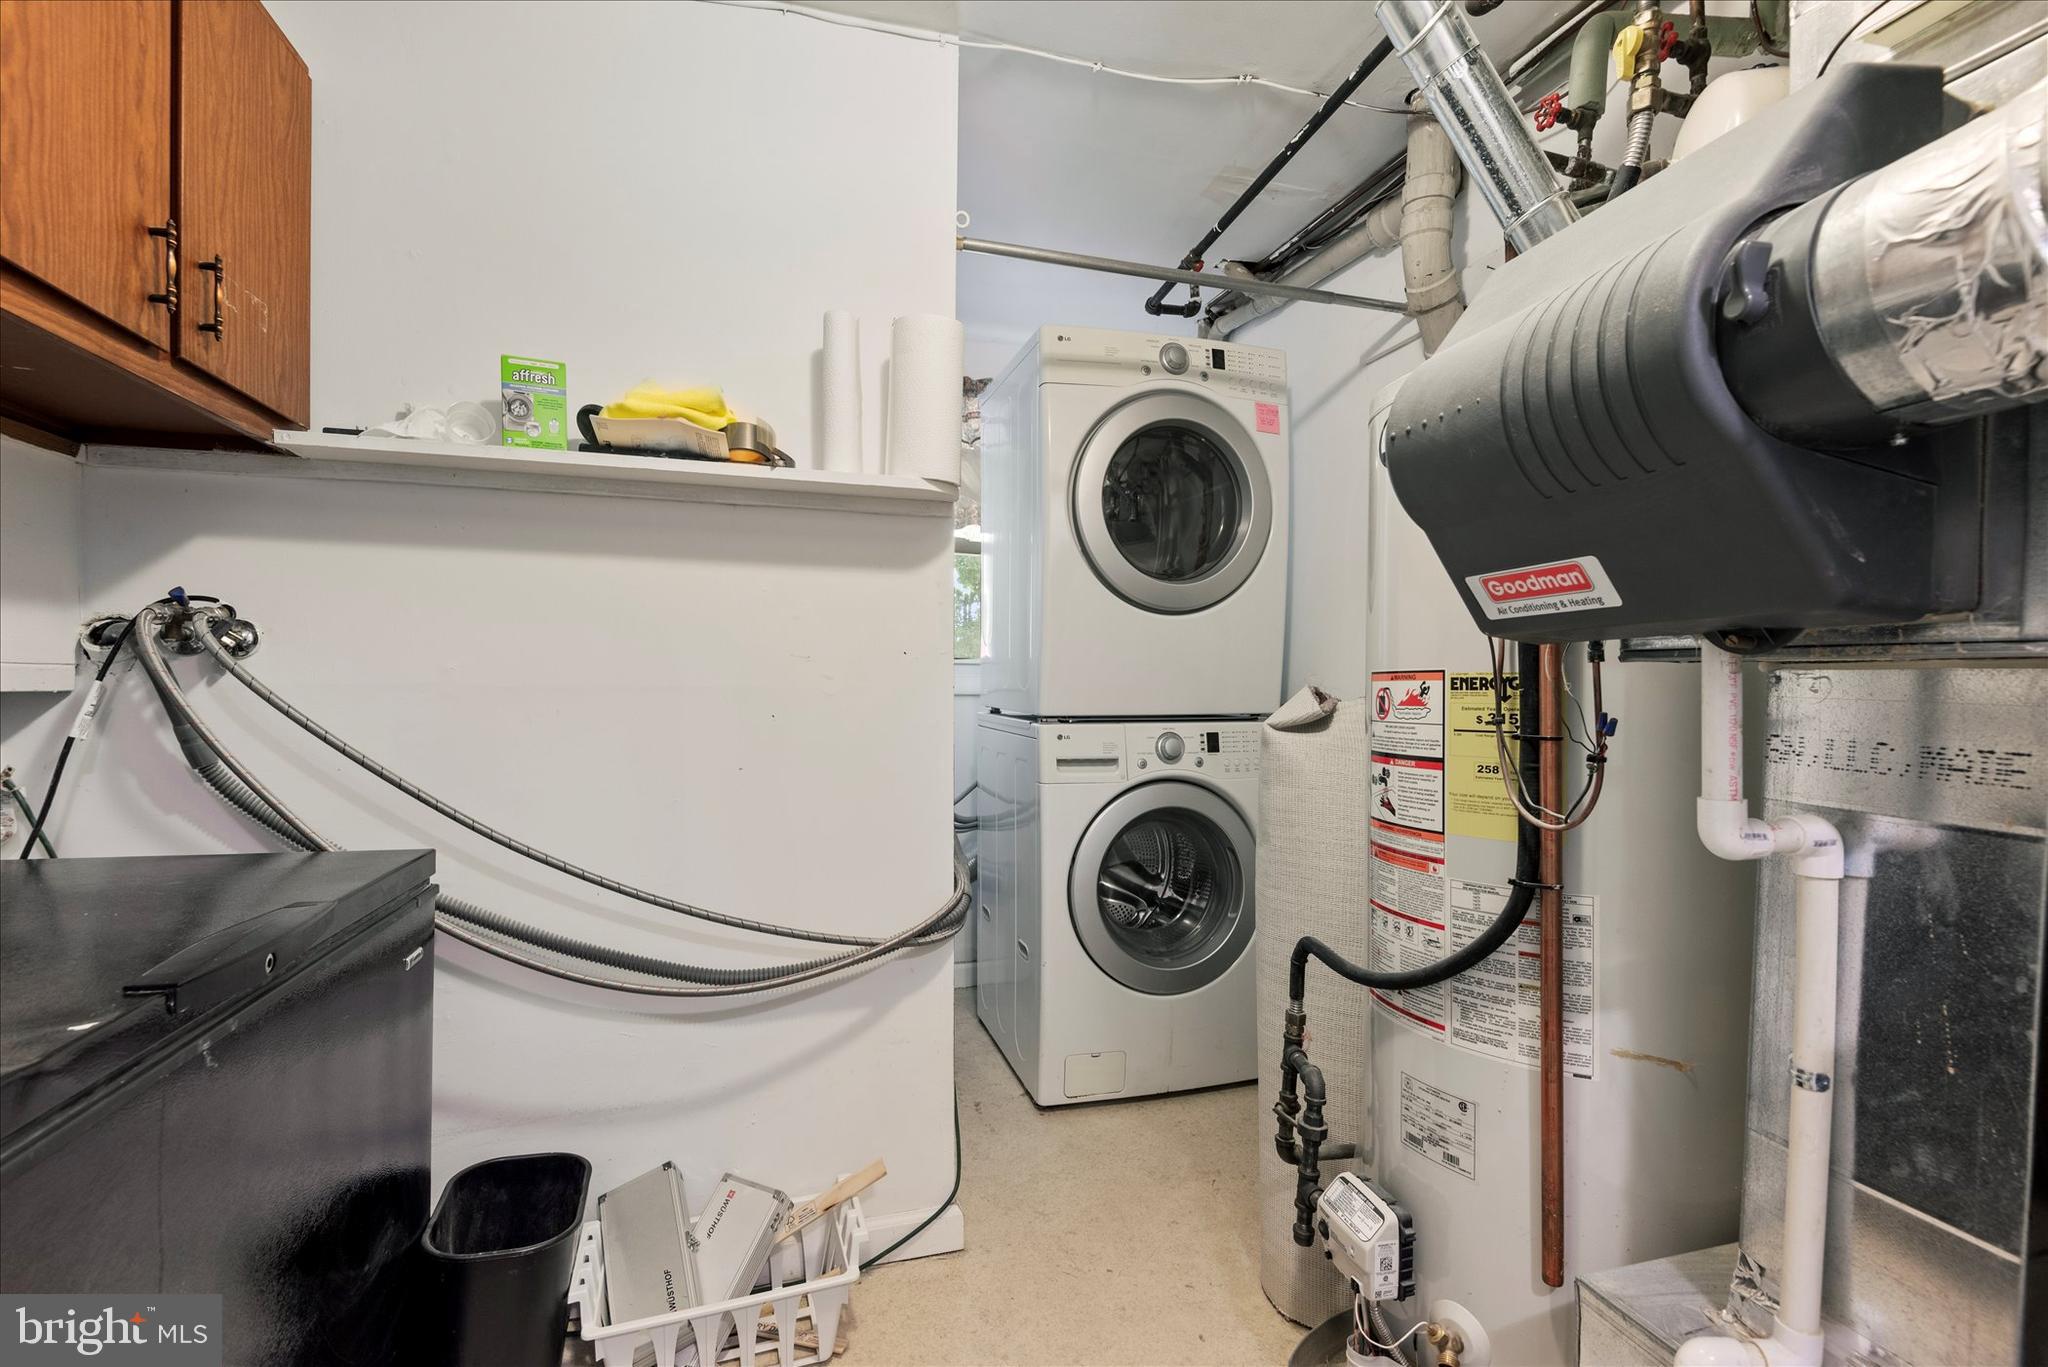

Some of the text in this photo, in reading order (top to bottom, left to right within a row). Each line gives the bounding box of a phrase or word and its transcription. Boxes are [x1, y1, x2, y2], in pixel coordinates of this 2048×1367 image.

[512, 369, 555, 385] affresh
[1488, 571, 1585, 596] Goodman
[1498, 596, 1605, 615] Air Conditioning & Heating
[1395, 759, 1415, 767] DANGER
[1477, 765, 1499, 774] 258
